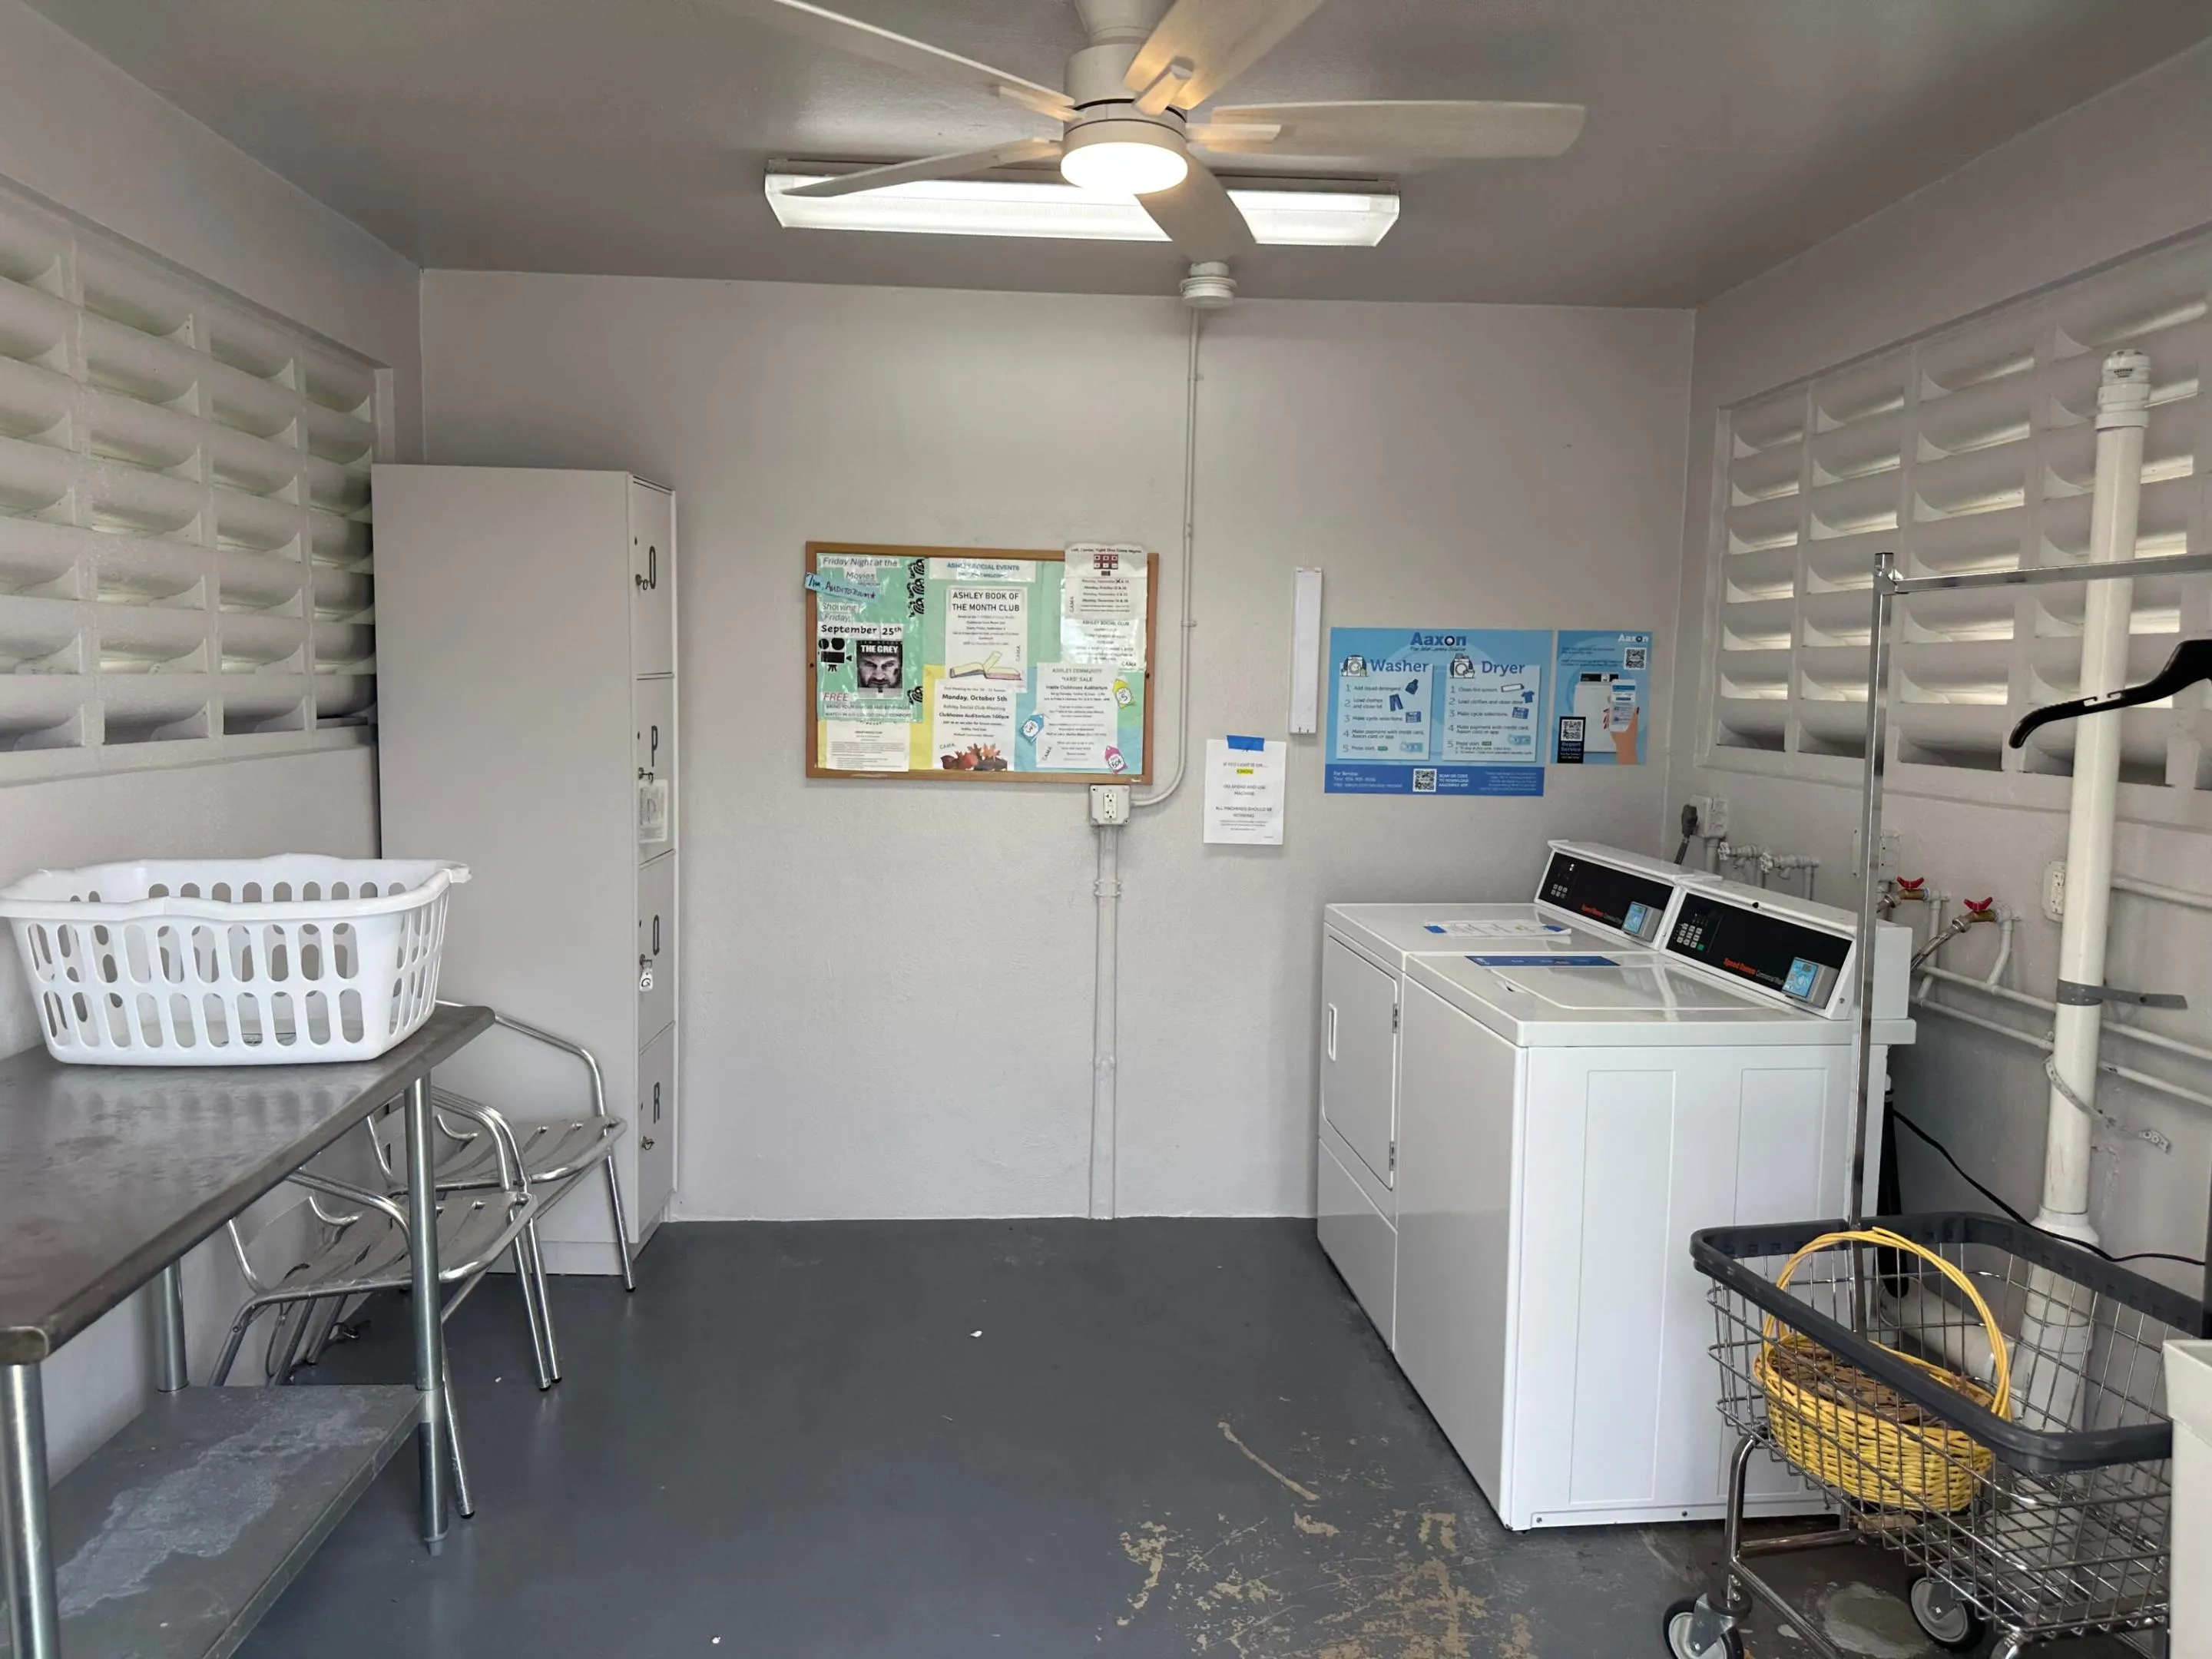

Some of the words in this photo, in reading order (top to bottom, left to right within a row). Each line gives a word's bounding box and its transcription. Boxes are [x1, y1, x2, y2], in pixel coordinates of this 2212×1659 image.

[823, 557, 847, 568] Friday
[850, 558, 873, 568] Night
[846, 571, 875, 580] Movies
[952, 591, 983, 600] ASHLEY
[1008, 592, 1019, 601] OF
[952, 603, 967, 611] THE
[998, 604, 1020, 612] CLUB
[821, 624, 877, 635] September
[882, 626, 902, 636] 25th
[1410, 631, 1467, 646] Aaxon
[1618, 633, 1650, 643] Aaxon
[860, 644, 876, 654] THE
[876, 645, 899, 654] GREY
[1370, 659, 1429, 673] Washer
[1482, 661, 1525, 677] Dryer
[1346, 684, 1351, 692] 1
[823, 693, 849, 702] FREE
[1449, 697, 1455, 706] 2
[1344, 699, 1351, 707] 2
[1449, 709, 1455, 717] 3
[1344, 714, 1350, 723] 3
[1447, 724, 1455, 733] 4
[1343, 730, 1349, 738] 4
[651, 725, 657, 767] P
[1343, 744, 1349, 753] 5
[653, 1081, 661, 1124] R
